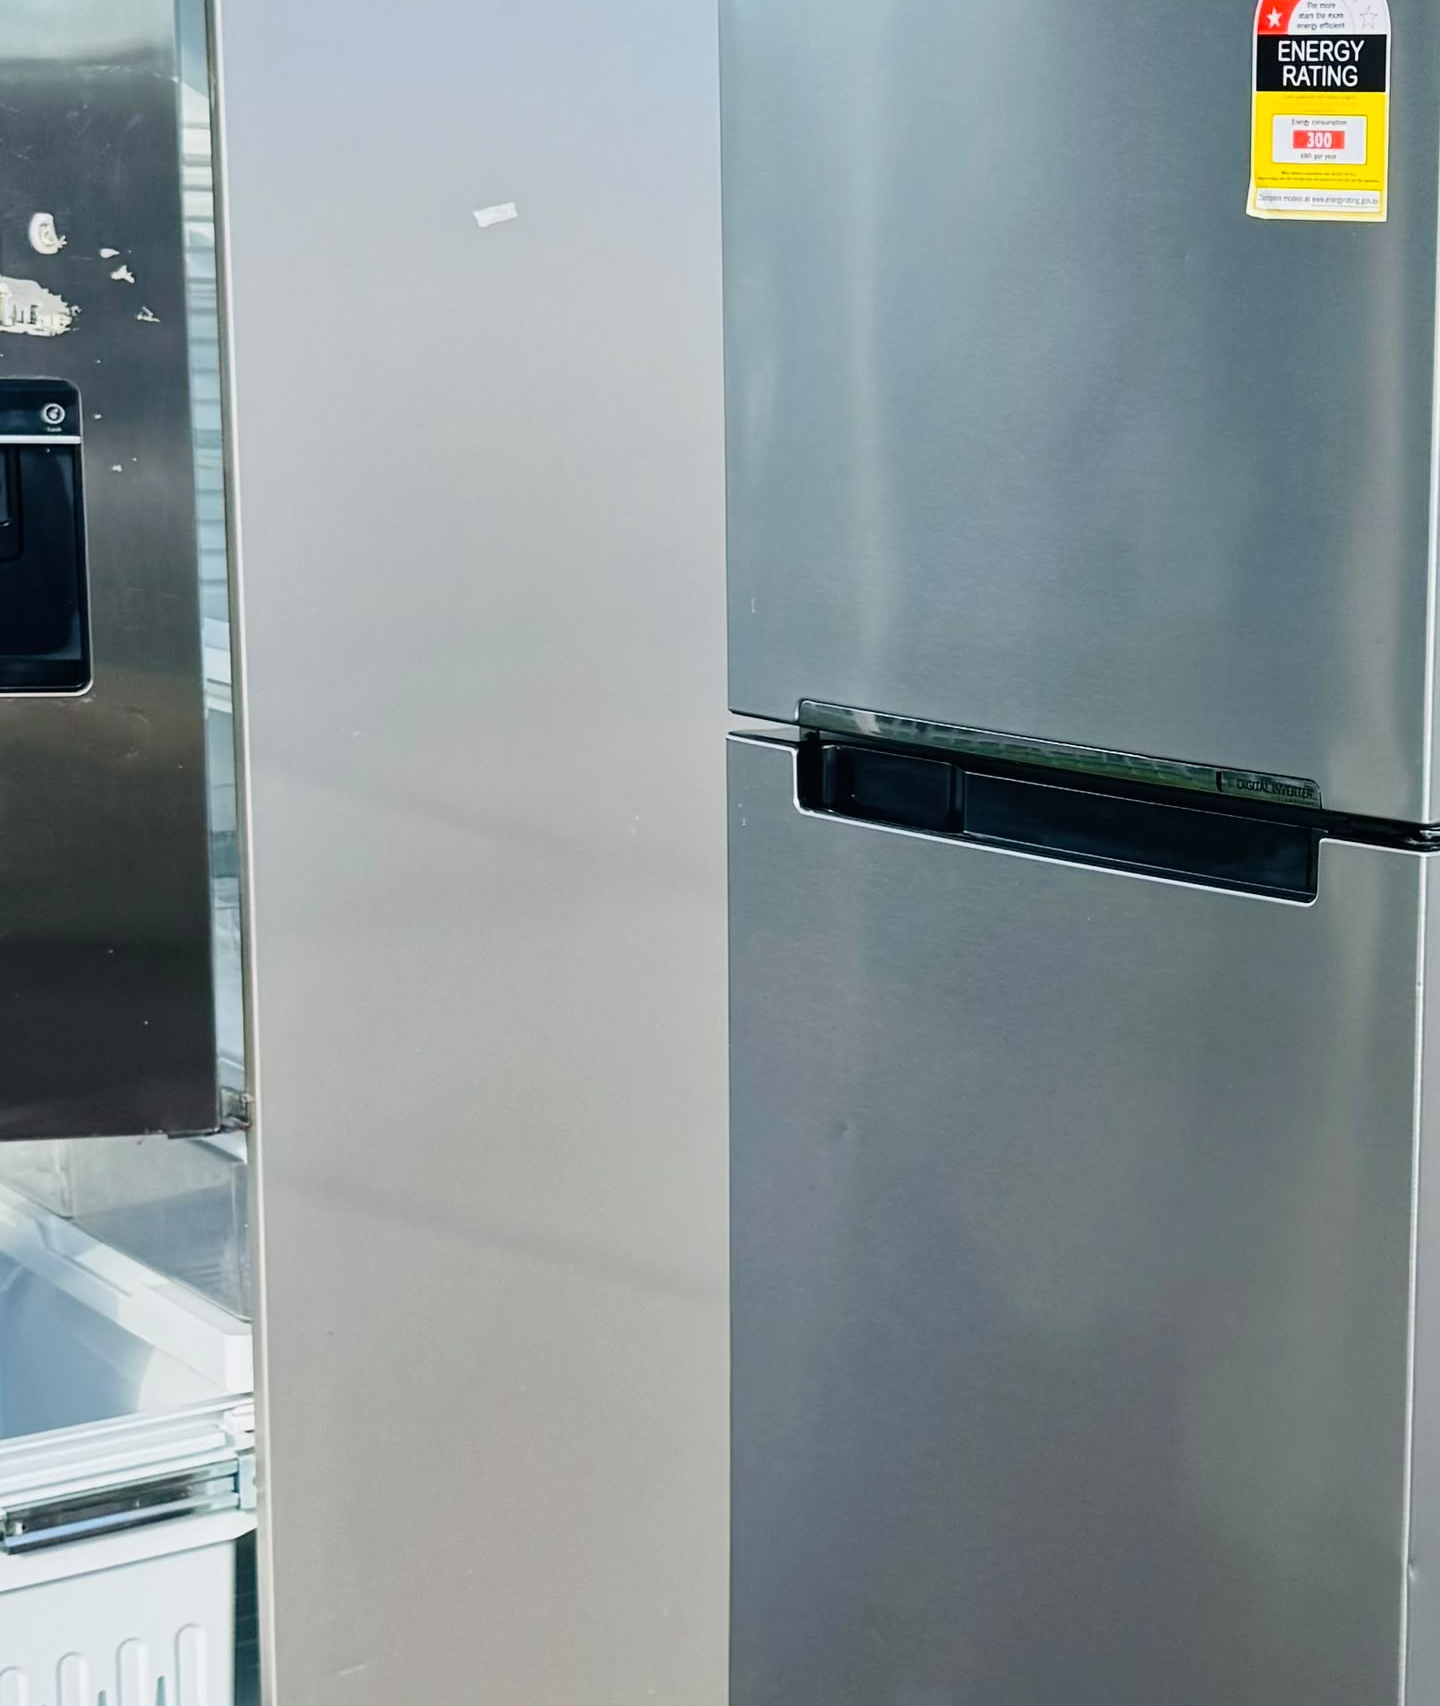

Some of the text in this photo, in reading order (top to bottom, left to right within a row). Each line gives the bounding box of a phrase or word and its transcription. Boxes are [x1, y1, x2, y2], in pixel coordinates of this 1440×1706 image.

[1278, 40, 1364, 62] ENERGY
[1282, 65, 1359, 87] RATING
[1306, 131, 1333, 148] 300
